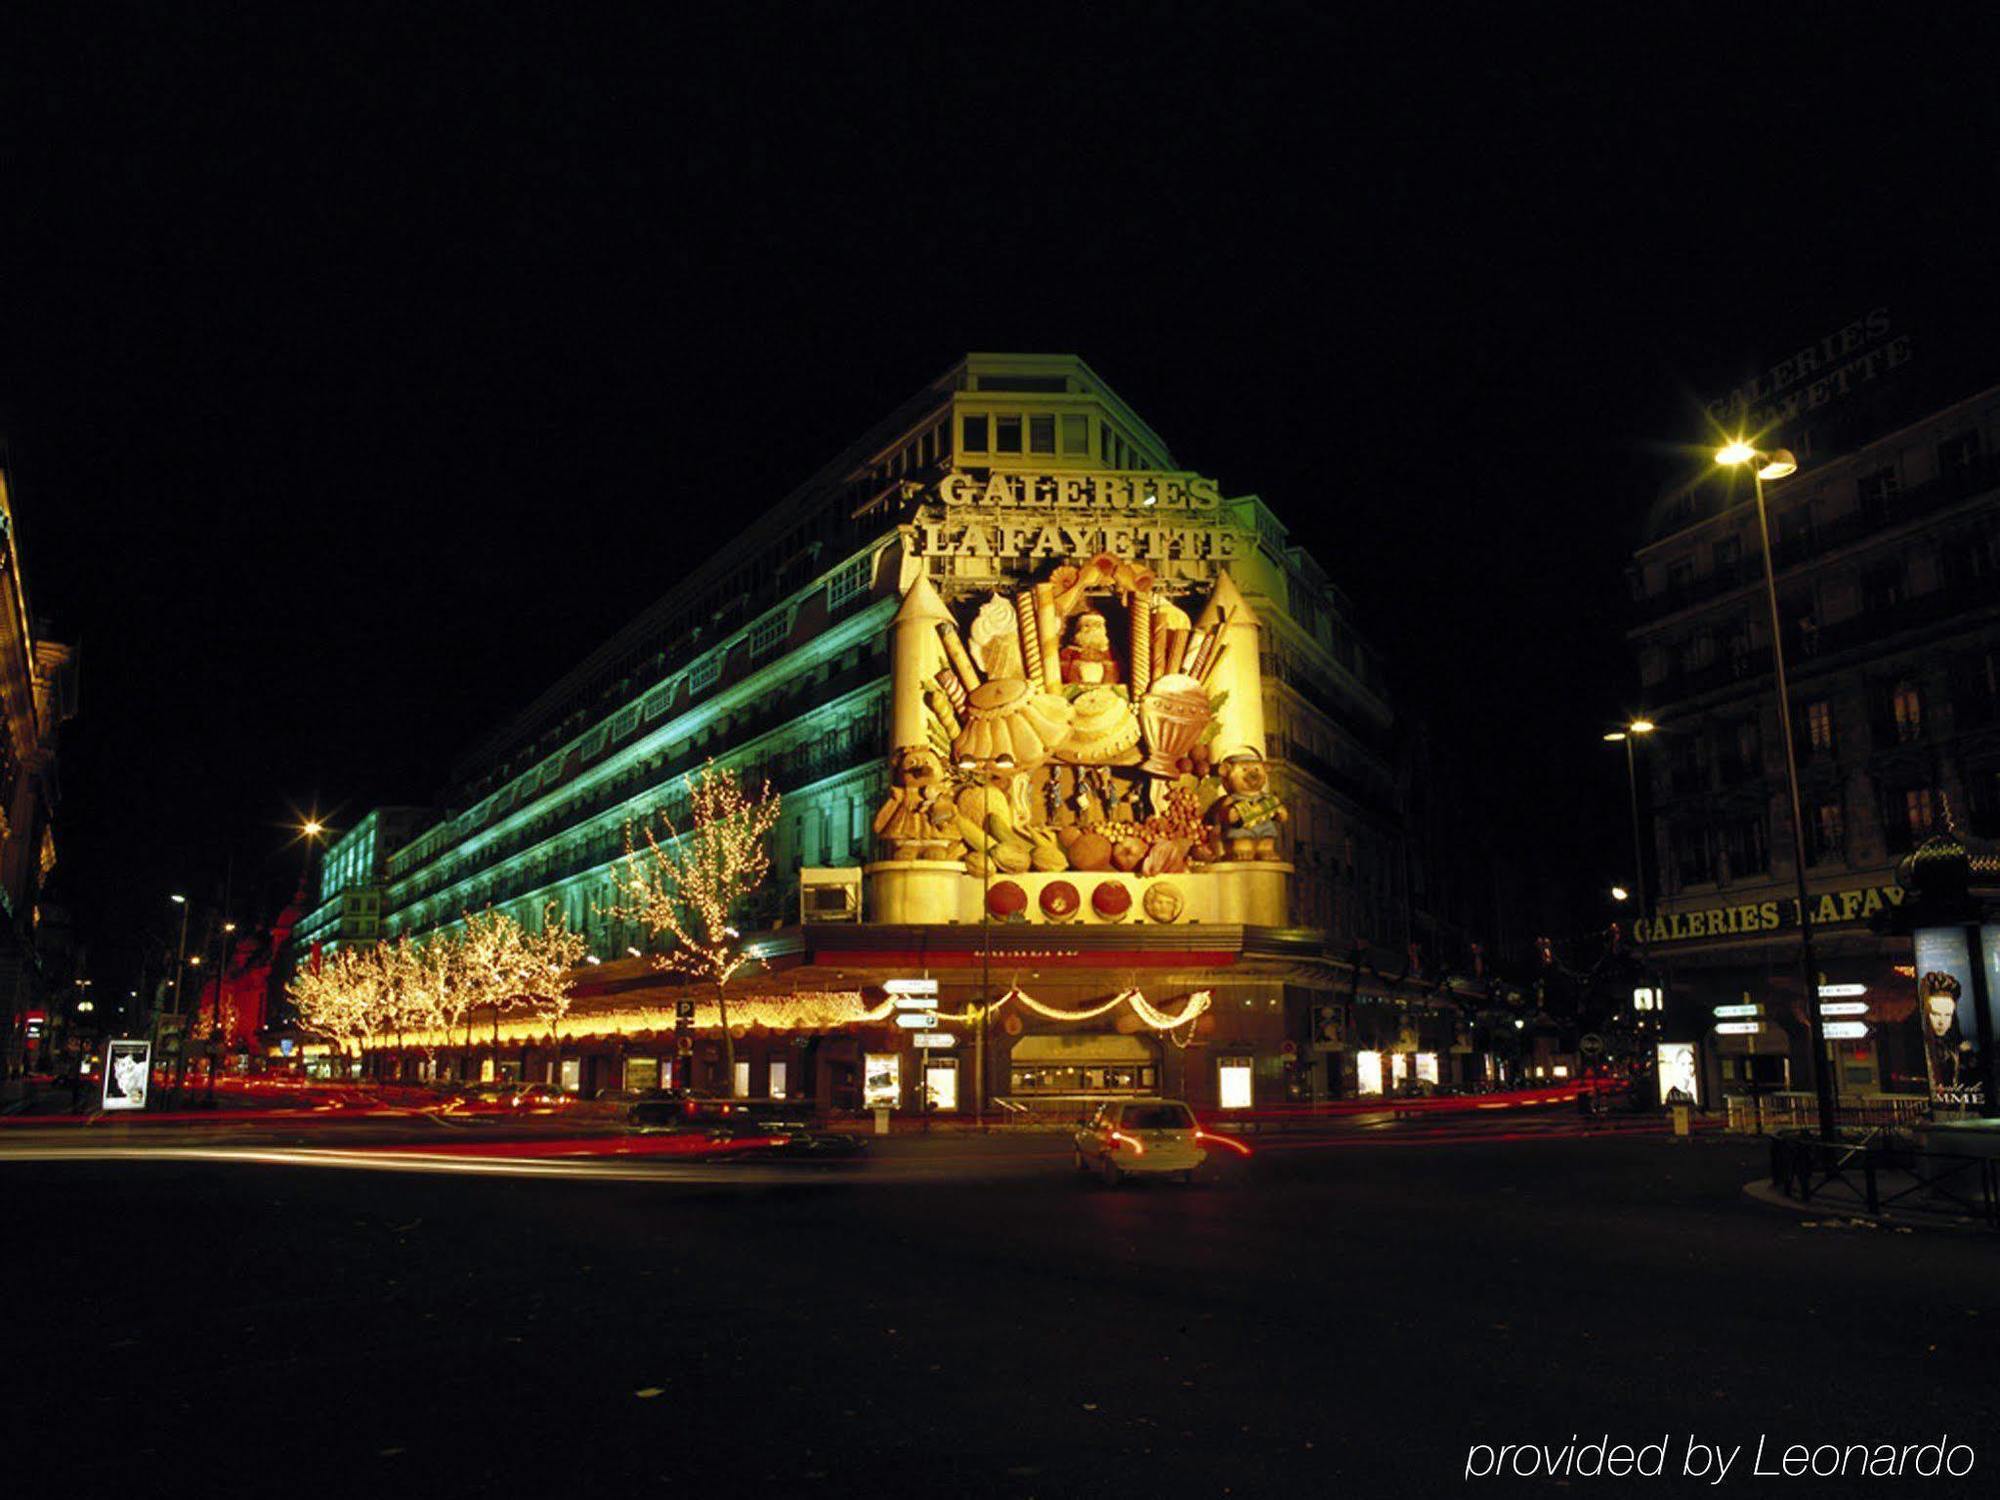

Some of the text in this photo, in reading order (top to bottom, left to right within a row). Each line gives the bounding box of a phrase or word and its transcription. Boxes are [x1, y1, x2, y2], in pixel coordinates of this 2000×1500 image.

[940, 474, 1219, 510] GALERIES
[921, 523, 1240, 560] LAFAYETTE
[1633, 901, 1780, 943] GALERIES
